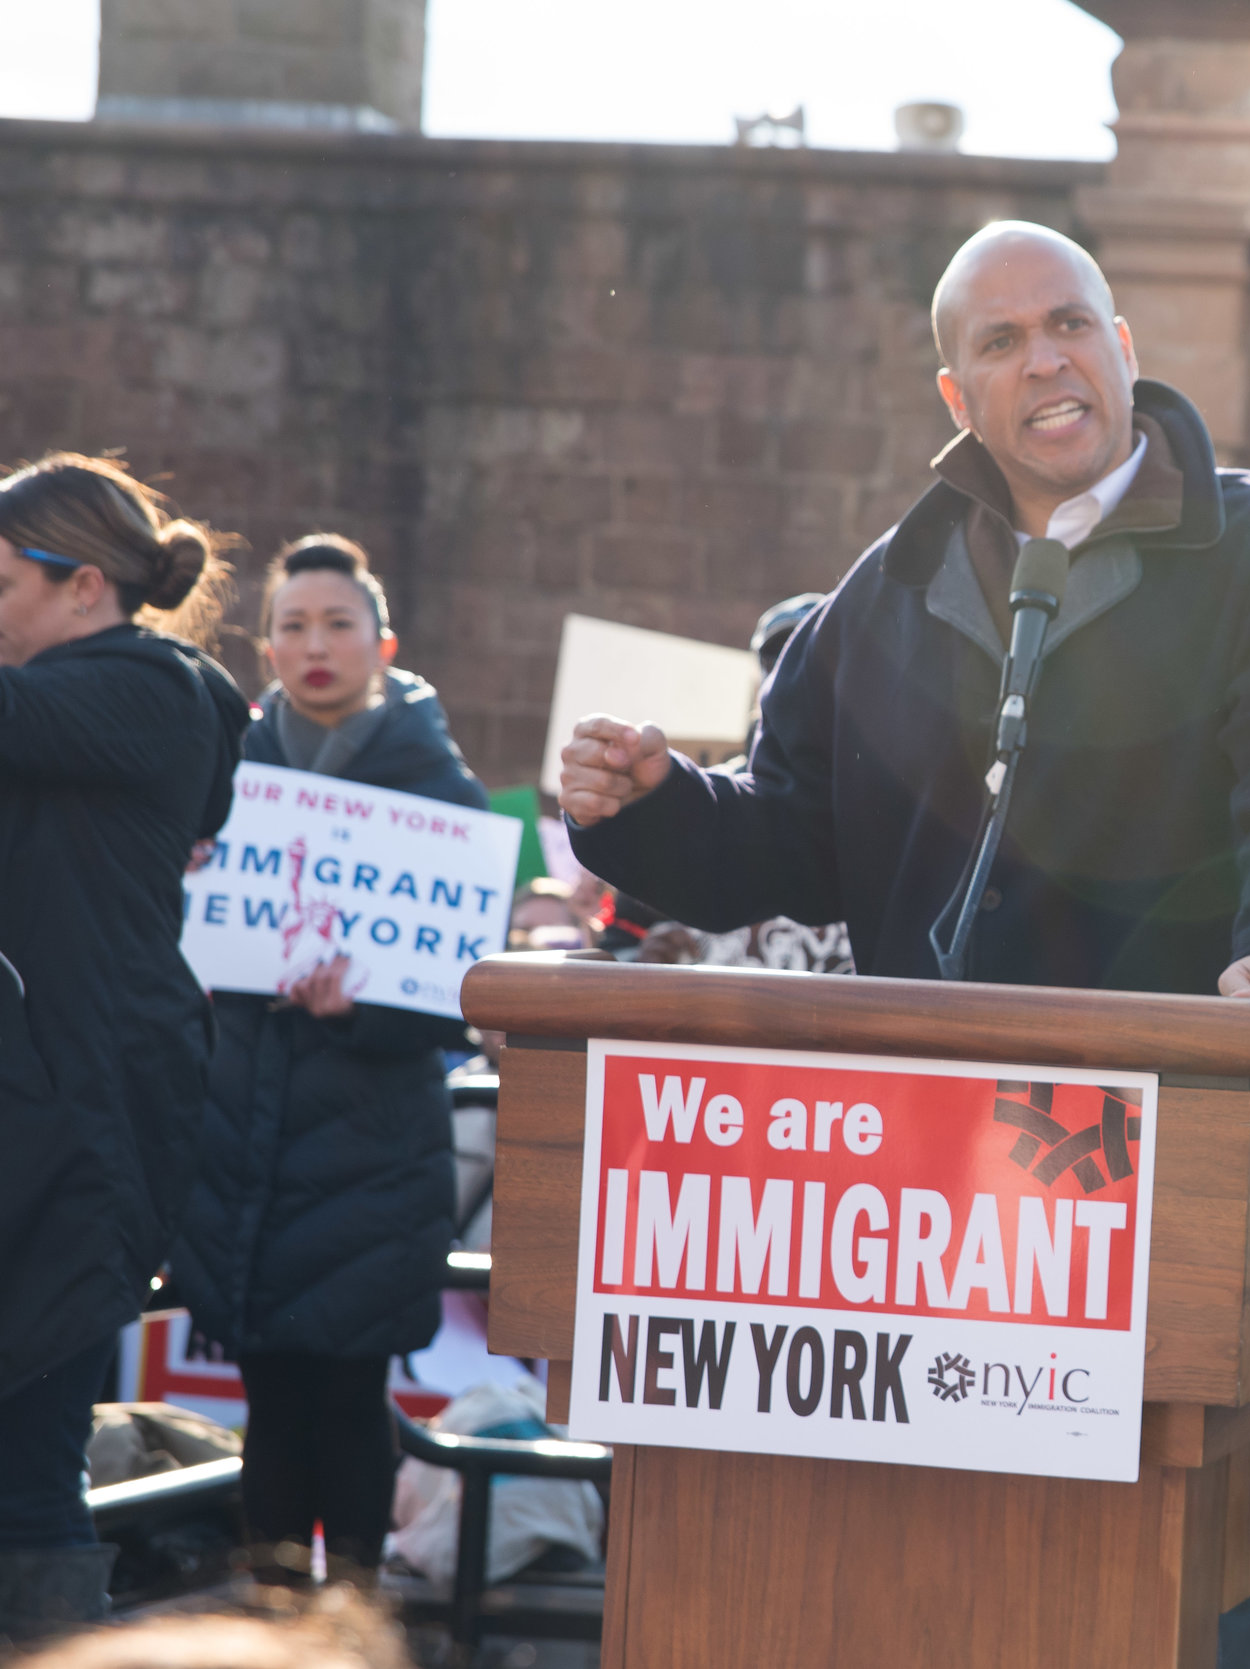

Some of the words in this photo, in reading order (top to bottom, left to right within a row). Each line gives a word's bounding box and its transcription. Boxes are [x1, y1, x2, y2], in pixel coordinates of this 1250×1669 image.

[235, 778, 281, 801] UR
[297, 791, 373, 819] NEW
[388, 806, 471, 841] YORK
[203, 841, 498, 913] MMIGRANT
[337, 910, 487, 961] YORK
[638, 1073, 744, 1147] We
[767, 1097, 884, 1156] are
[601, 1168, 1127, 1320] IMMIGRANT
[598, 1313, 736, 1411] NEW
[749, 1322, 913, 1424] YORK
[982, 1352, 1090, 1415] nyic
[999, 1401, 1017, 1409] YORK
[1028, 1403, 1077, 1413] IMMIGRATION
[1080, 1406, 1120, 1416] COALITION
